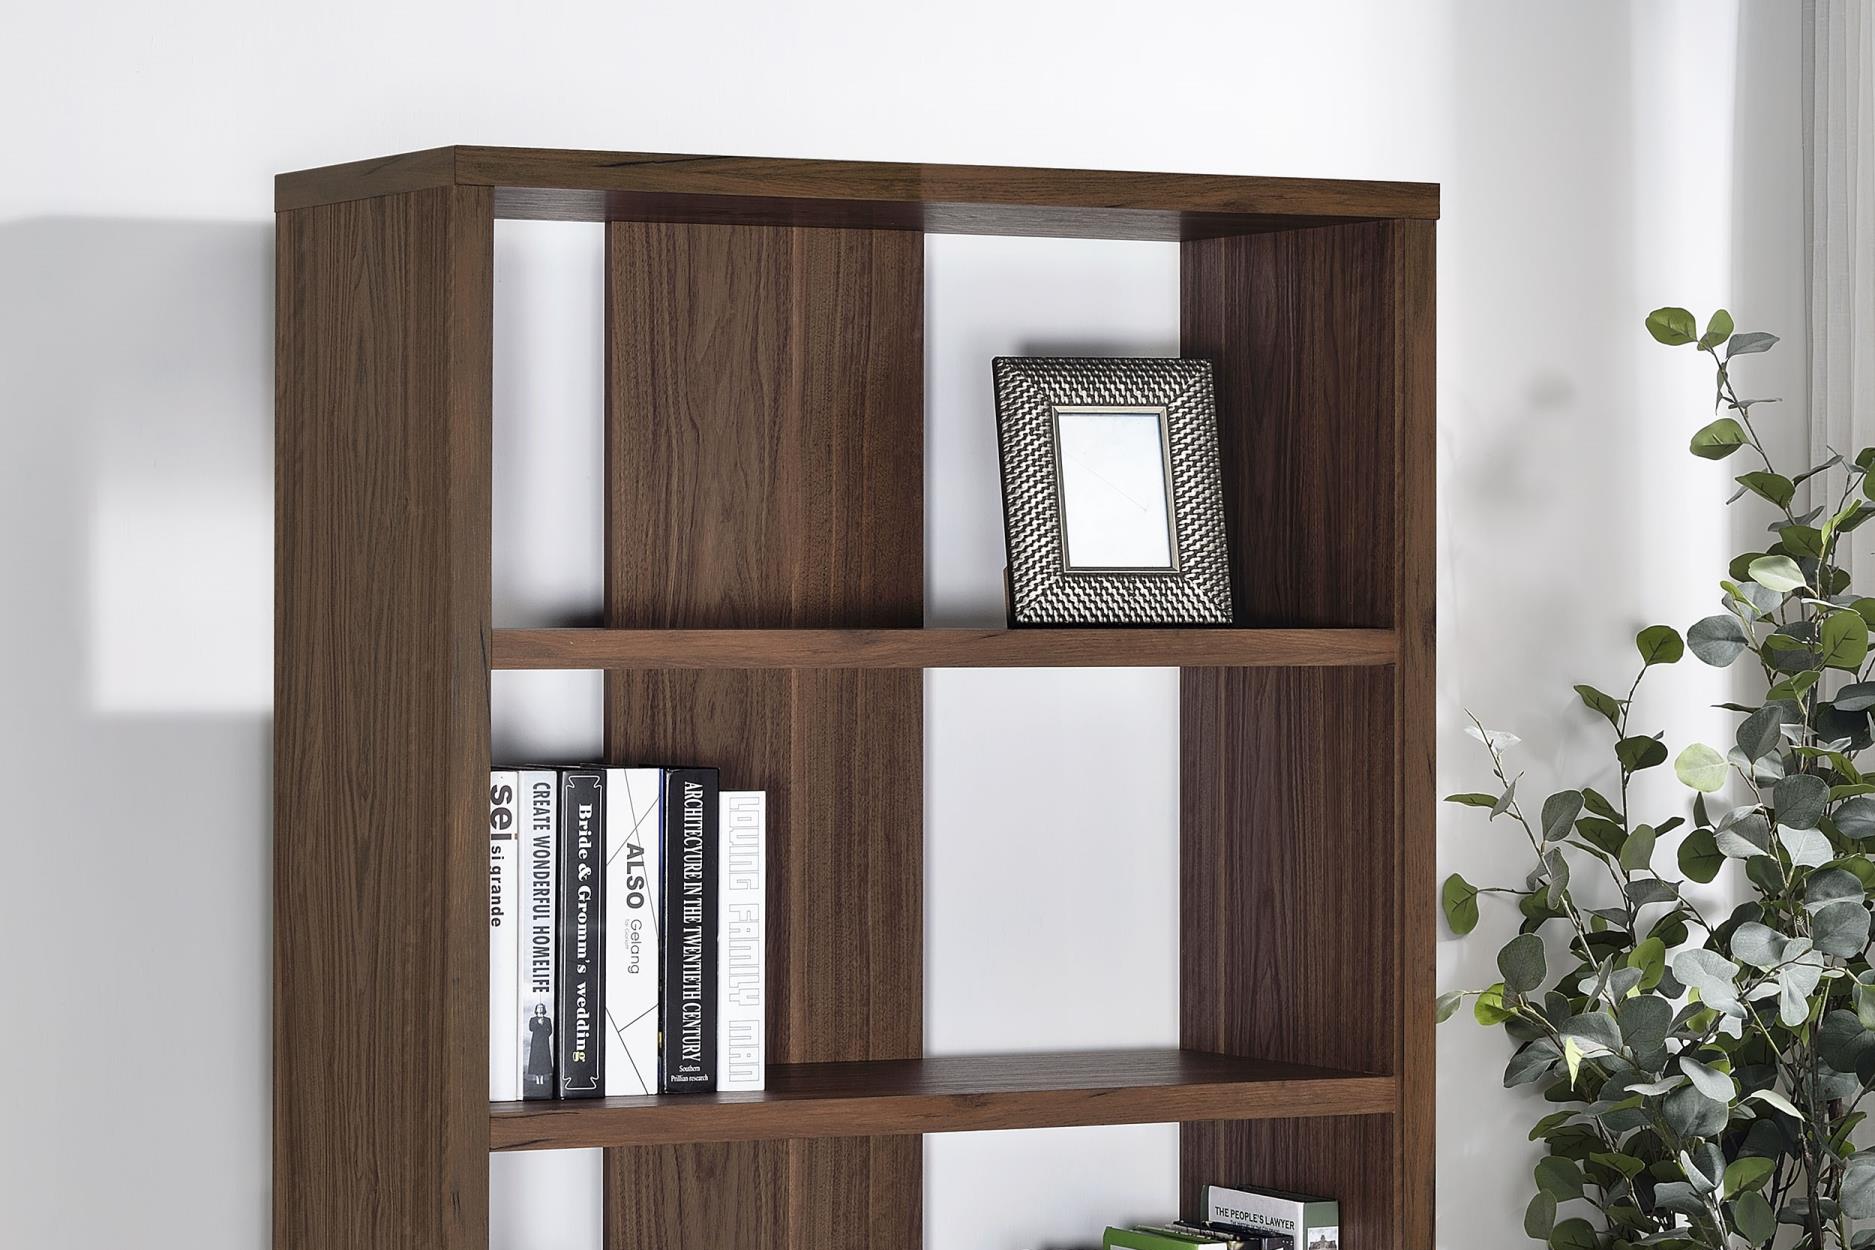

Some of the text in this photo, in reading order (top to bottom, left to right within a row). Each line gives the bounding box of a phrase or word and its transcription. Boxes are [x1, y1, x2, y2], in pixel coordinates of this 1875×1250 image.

[490, 784, 518, 927] sei si grande
[578, 804, 592, 840] Bride
[532, 782, 550, 993] CREATE WONDERFUL HOMELIFE
[578, 864, 592, 881] &
[626, 842, 644, 910] ALSO
[628, 919, 642, 974] Gelang
[682, 781, 703, 1062] ARCHITECYURE IN THE TWENTIETH CENTURY
[728, 904, 760, 1006] FAMILY
[573, 982, 590, 1062] wedding
[728, 1020, 760, 1082] MAN
[1215, 1206, 1229, 1218] THE
[1230, 1210, 1264, 1224] PEOPLE'S
[1265, 1216, 1294, 1230] LAWYER
